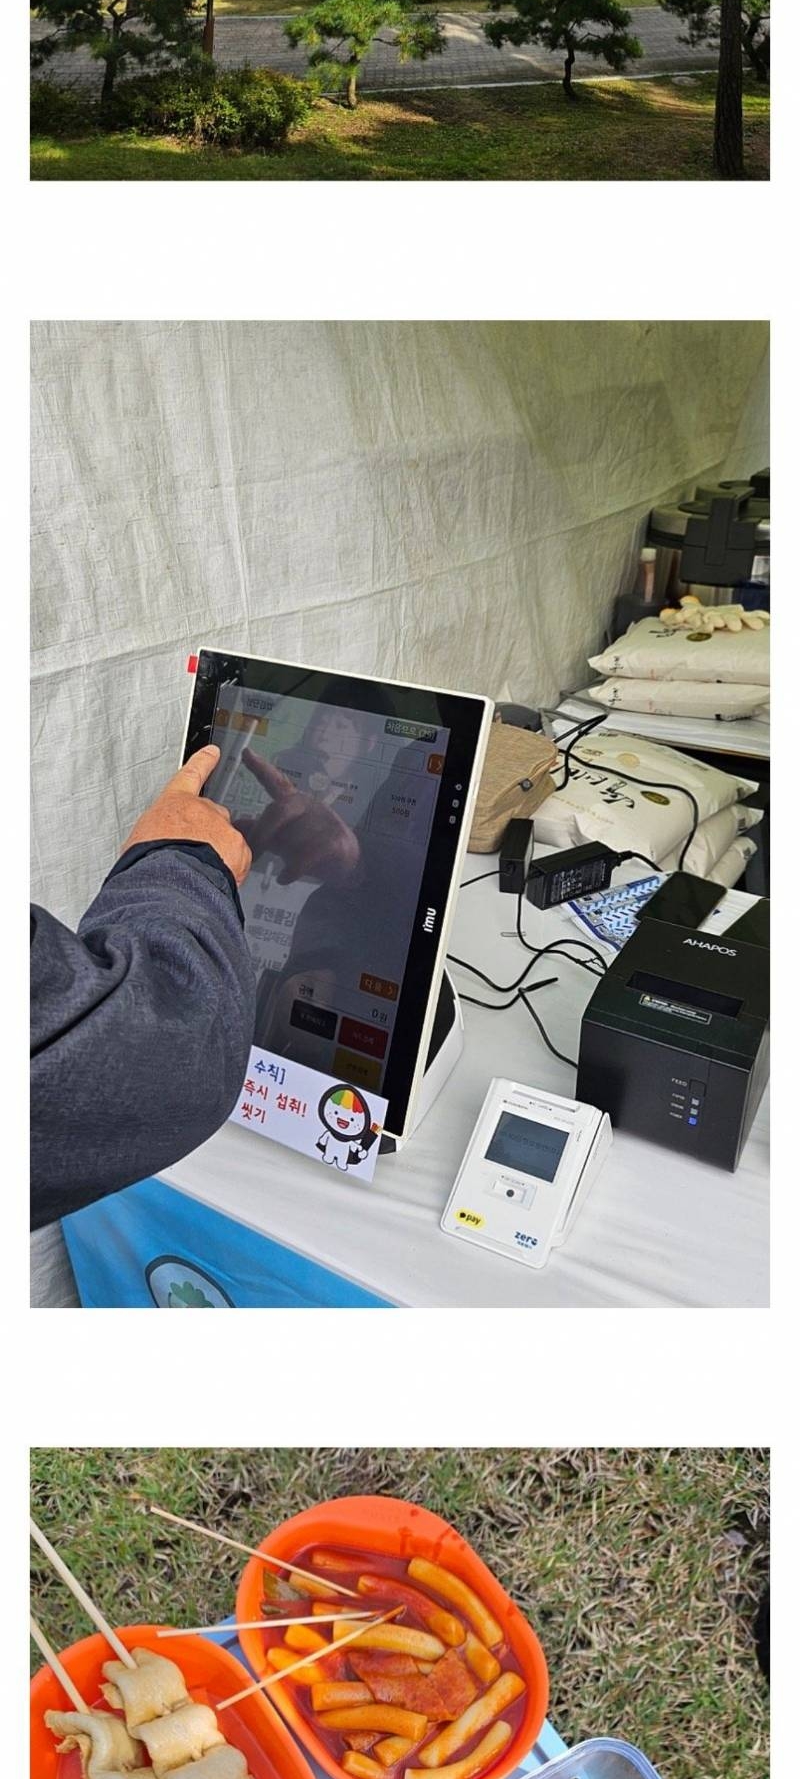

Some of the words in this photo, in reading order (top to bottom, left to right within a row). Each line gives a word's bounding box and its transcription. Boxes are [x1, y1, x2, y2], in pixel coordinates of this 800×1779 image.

[683, 937, 738, 957] AHAPOS
[254, 1059, 286, 1085] 수칙]
[243, 1078, 269, 1100] 즉시
[276, 1093, 307, 1117] 섭취!
[241, 1102, 266, 1124] 씻기
[466, 1212, 482, 1225] pay
